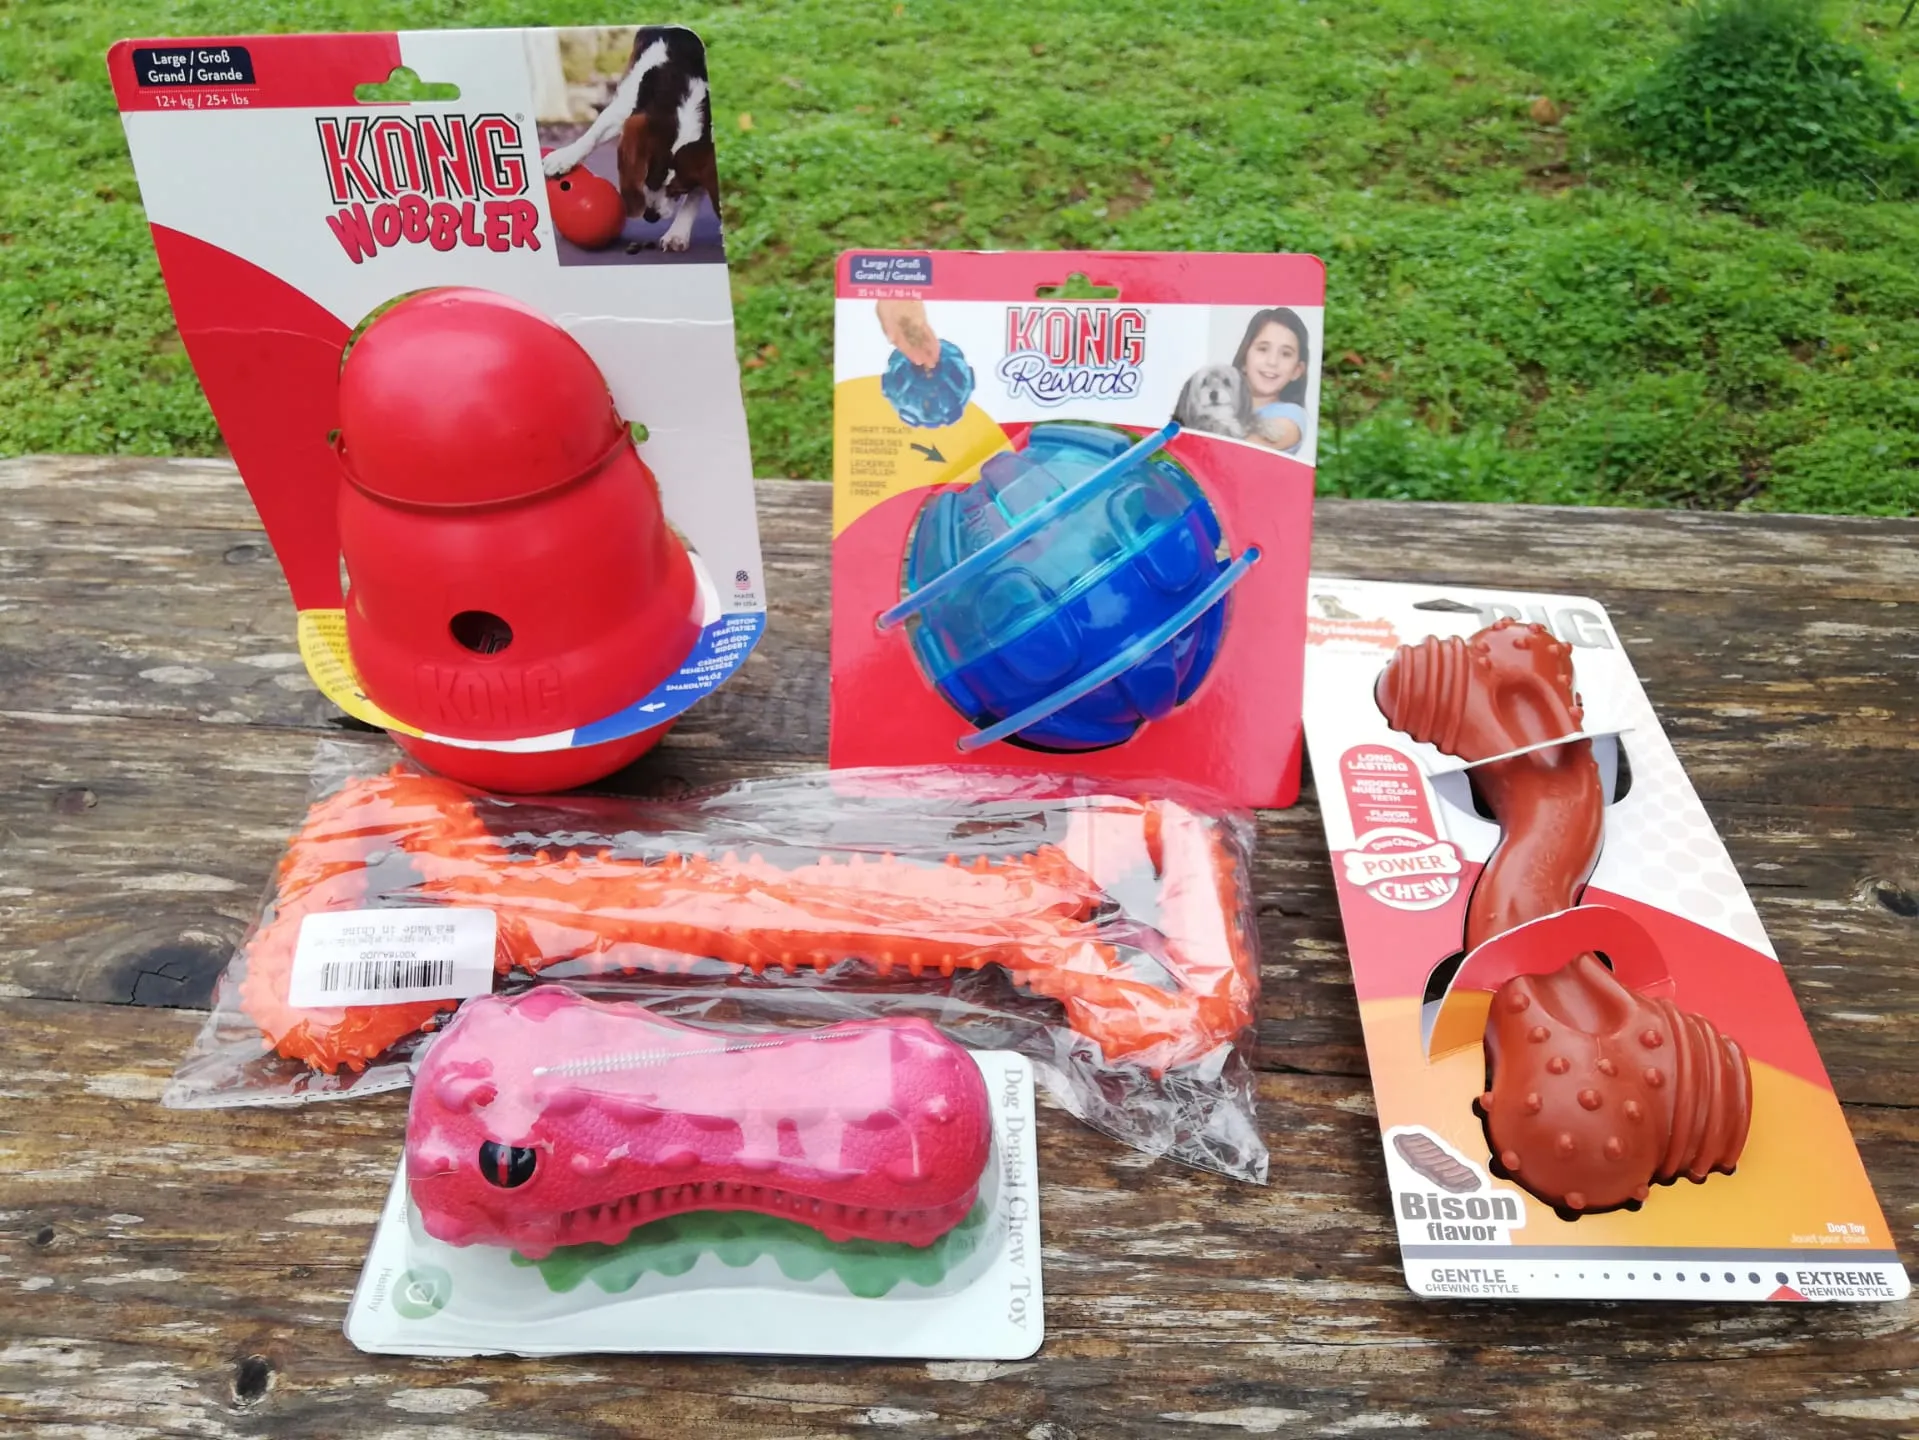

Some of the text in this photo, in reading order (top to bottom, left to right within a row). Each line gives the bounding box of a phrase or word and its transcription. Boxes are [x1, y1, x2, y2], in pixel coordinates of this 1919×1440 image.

[152, 52, 186, 67] Large
[198, 49, 231, 64] Groß
[148, 69, 187, 83] Grand
[197, 67, 243, 81] Grande
[155, 95, 177, 107] 12+
[180, 93, 195, 109] kg
[205, 94, 229, 106] 25+
[231, 92, 250, 105] lbs
[315, 113, 529, 204] KONG
[325, 193, 542, 265] WOBBLER
[861, 258, 888, 270] Large
[855, 270, 884, 280] Grand
[892, 271, 927, 281] Grande
[1007, 307, 1145, 368] KONG
[1002, 354, 1138, 402] Rewards
[1471, 602, 1614, 650] BIG
[414, 660, 563, 726] KONG
[1347, 760, 1409, 772] LASTING
[1357, 753, 1394, 764] LONG
[1362, 855, 1447, 876] POWER
[1378, 876, 1450, 900] CHEW
[343, 924, 432, 936] Made in China
[1003, 1068, 1032, 1331] Dog Dental Chew Toy
[1400, 1192, 1518, 1220] Bison
[1426, 1222, 1497, 1241] flavor
[1826, 1222, 1866, 1235] Dog Toy
[1431, 1268, 1507, 1284] GENTLE
[1796, 1271, 1888, 1286] EXTREME
[367, 1267, 395, 1312] Healthy
[1425, 1283, 1520, 1294] CHEWING STYLE
[1800, 1287, 1896, 1297] CHEWING STYLE
